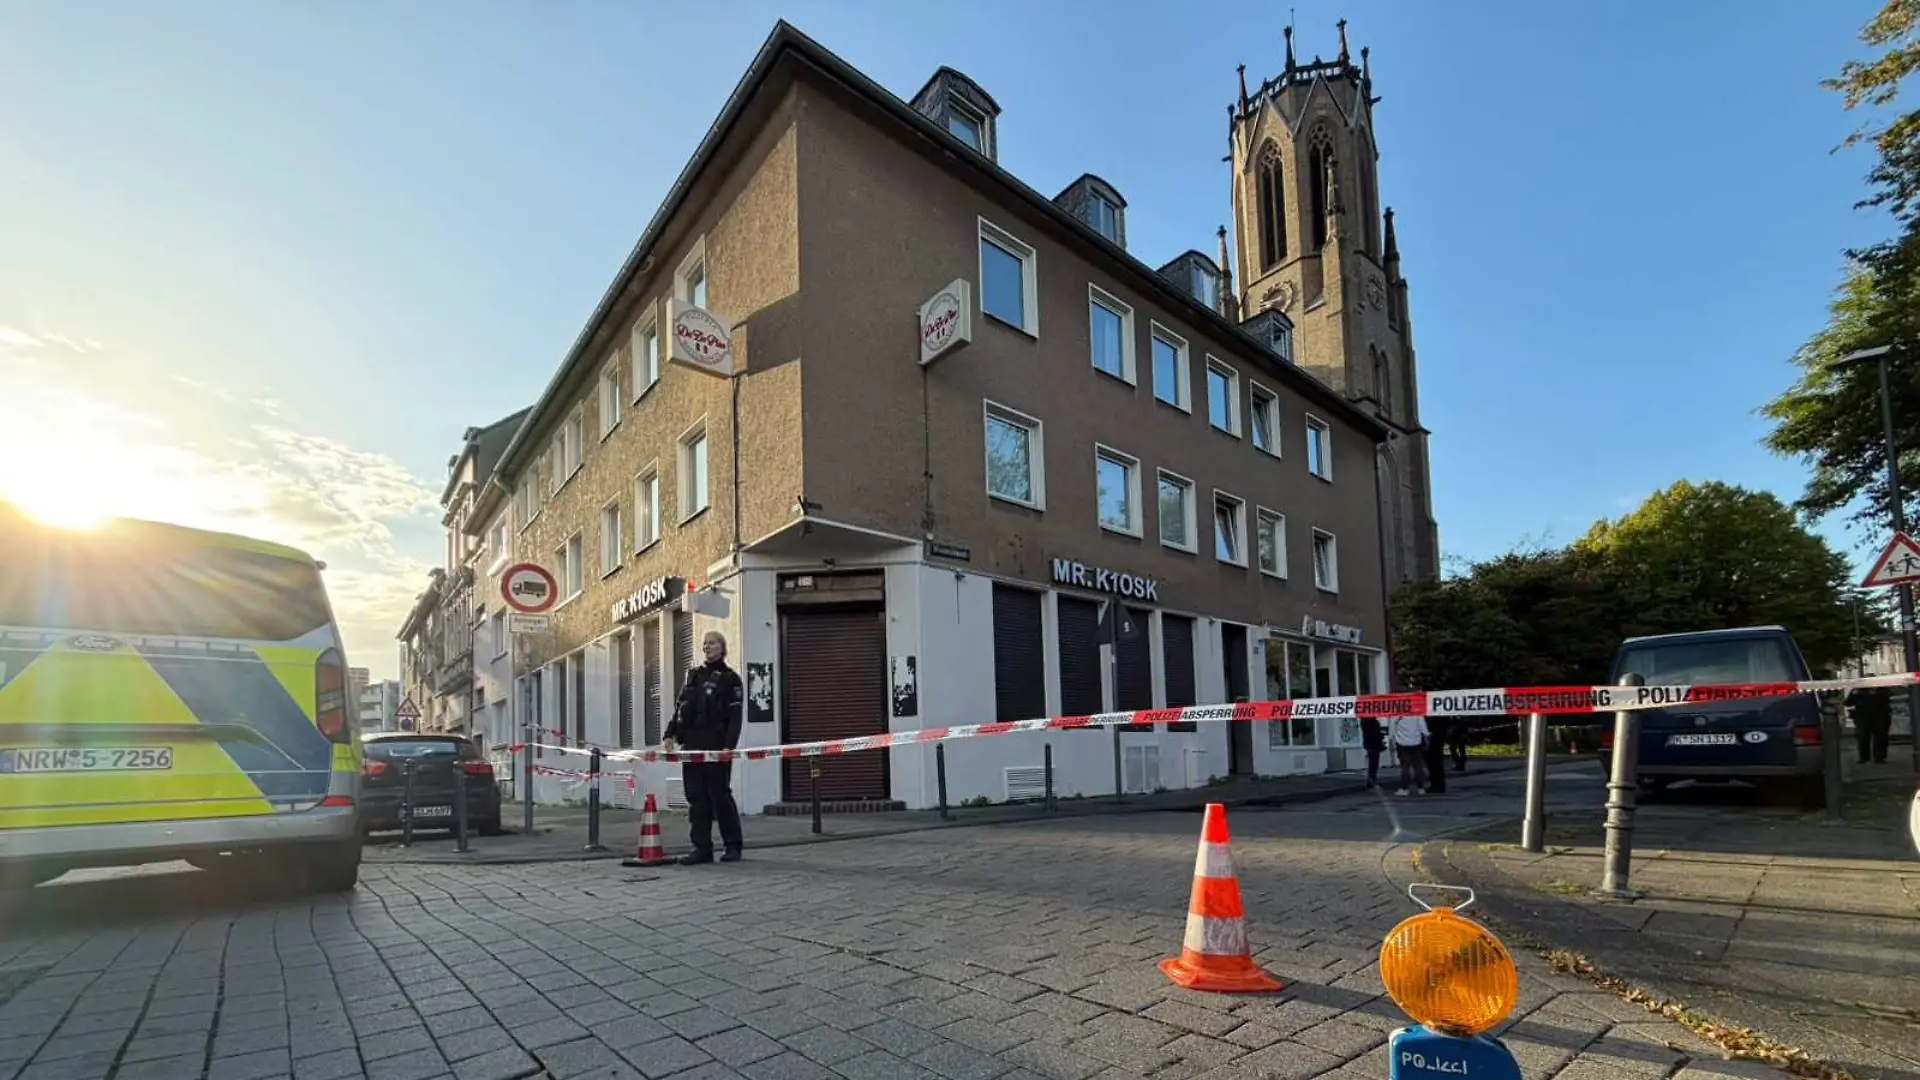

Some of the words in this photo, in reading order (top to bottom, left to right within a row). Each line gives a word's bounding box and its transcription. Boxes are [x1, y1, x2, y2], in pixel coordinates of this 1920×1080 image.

[1053, 557, 1093, 588] MR.
[1142, 705, 1257, 722] POLIZEIABSPERRUNG
[1271, 699, 1413, 717] POLIZEIABSPERRUNG
[1432, 688, 1612, 712] POLIZEIABSPERRUNG
[17, 751, 67, 769] NRW
[82, 750, 170, 768] 5-7256
